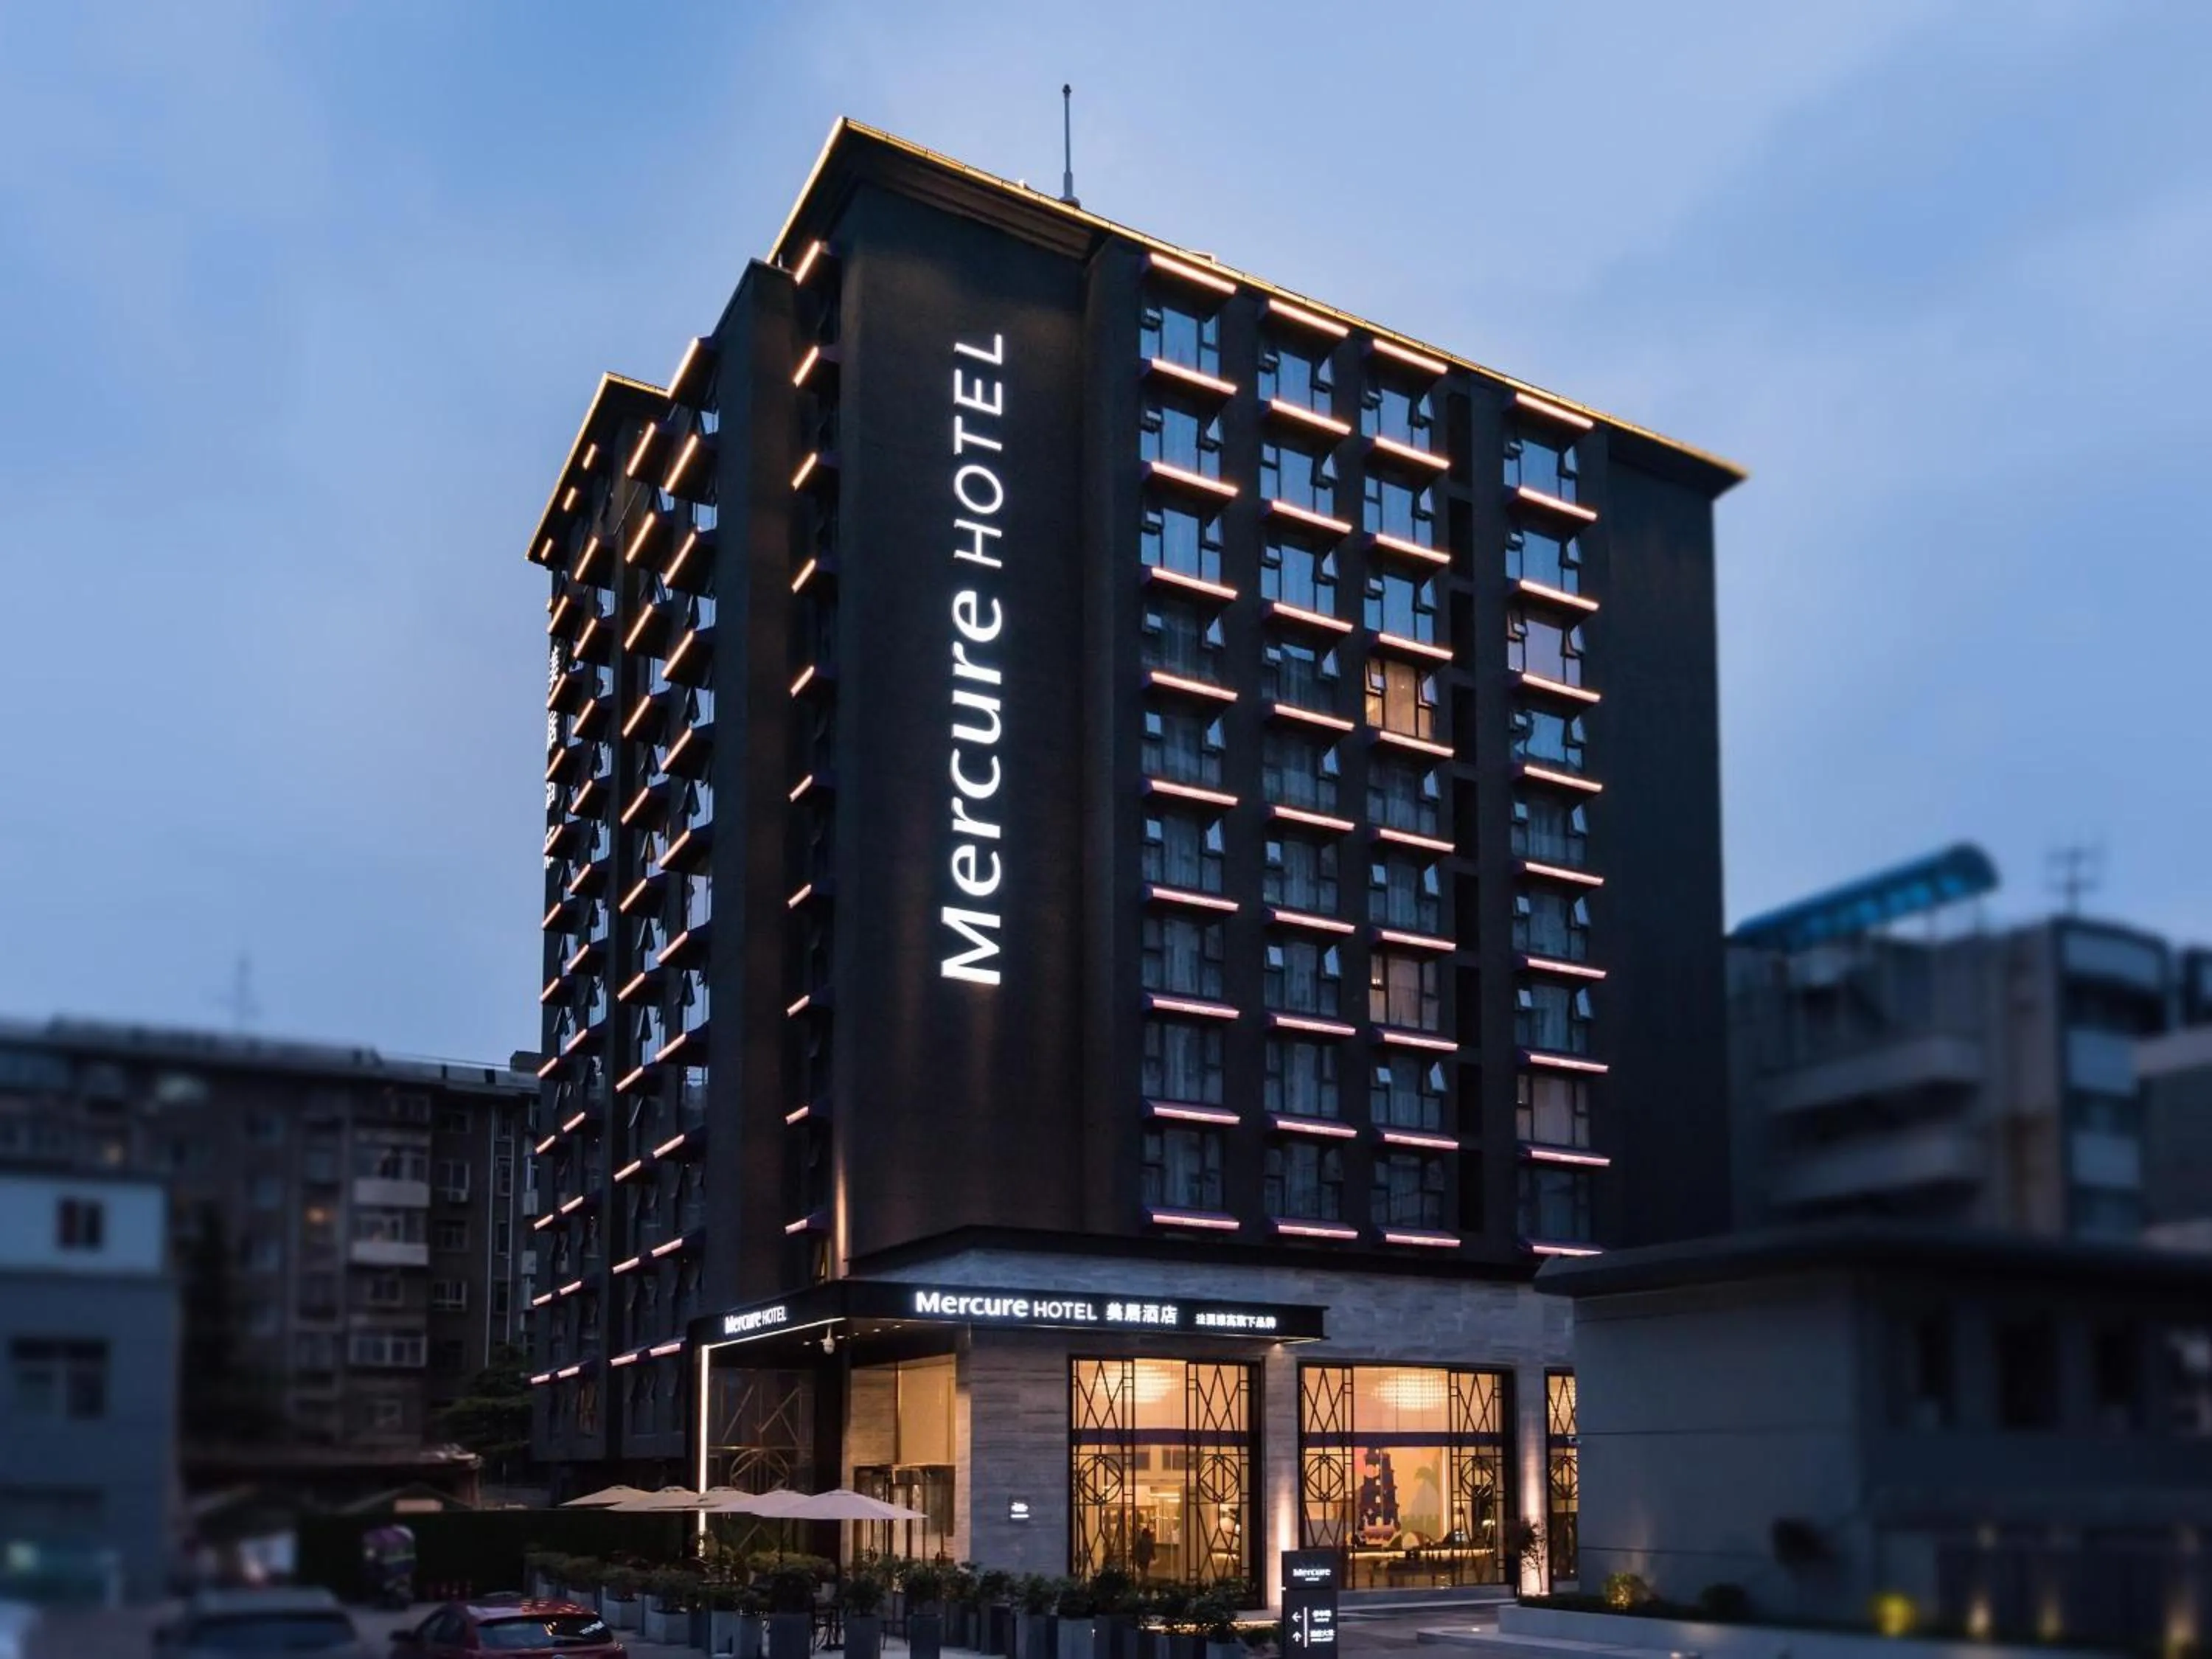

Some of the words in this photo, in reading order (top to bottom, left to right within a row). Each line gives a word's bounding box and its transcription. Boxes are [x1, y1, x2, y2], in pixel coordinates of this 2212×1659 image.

[953, 333, 1004, 568] HOTEL
[941, 589, 1003, 986] Mercure
[724, 1312, 761, 1335] Mercure
[762, 1305, 787, 1325] HOTEL
[915, 1291, 1029, 1318] Mercure
[1034, 1301, 1098, 1321] HOTEL
[1106, 1302, 1178, 1324] 美居酒店
[1293, 1568, 1332, 1576] Mercure
